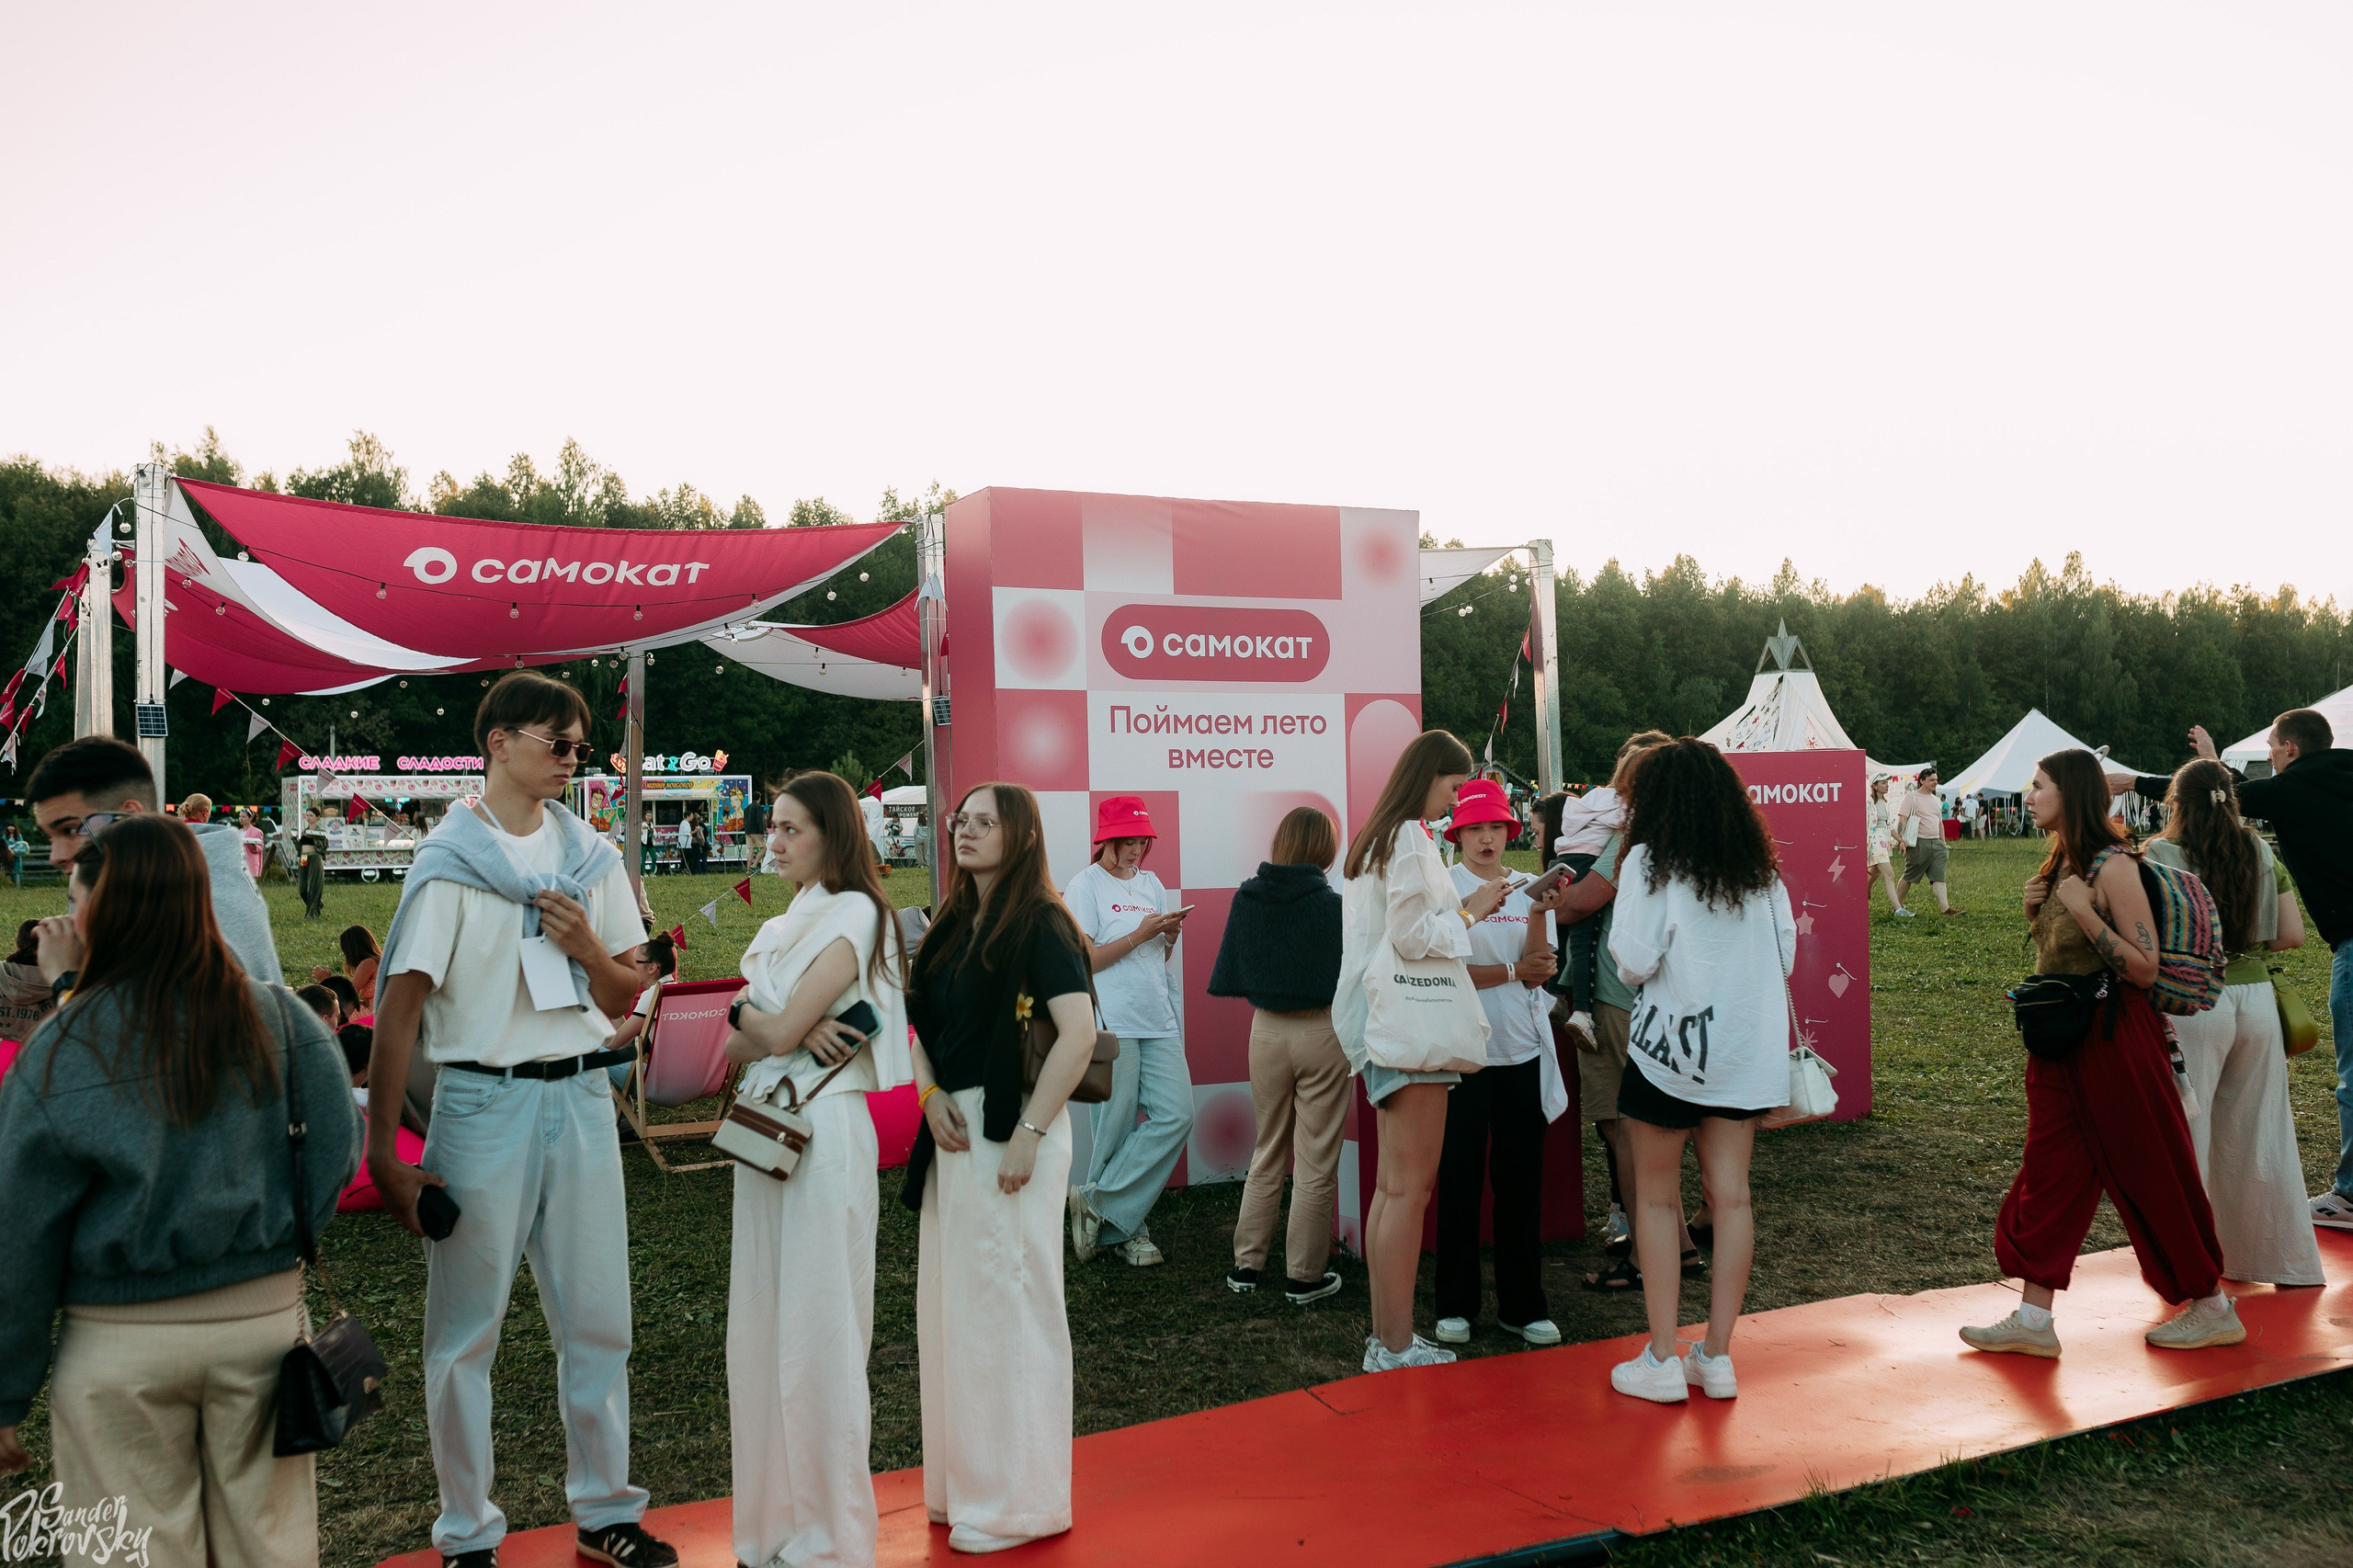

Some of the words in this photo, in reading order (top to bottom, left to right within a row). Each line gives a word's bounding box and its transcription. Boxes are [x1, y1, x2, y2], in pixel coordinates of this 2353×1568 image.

[472, 557, 710, 585] самокат
[1163, 633, 1313, 659] самокат
[1110, 704, 1253, 734] Поймаем
[1260, 715, 1327, 734] лето
[299, 756, 381, 770] СЛАДКИЕ
[397, 756, 484, 770] СЛАДОСТИ
[642, 752, 665, 770] at
[679, 751, 711, 771] Go
[1168, 748, 1274, 768] вместе
